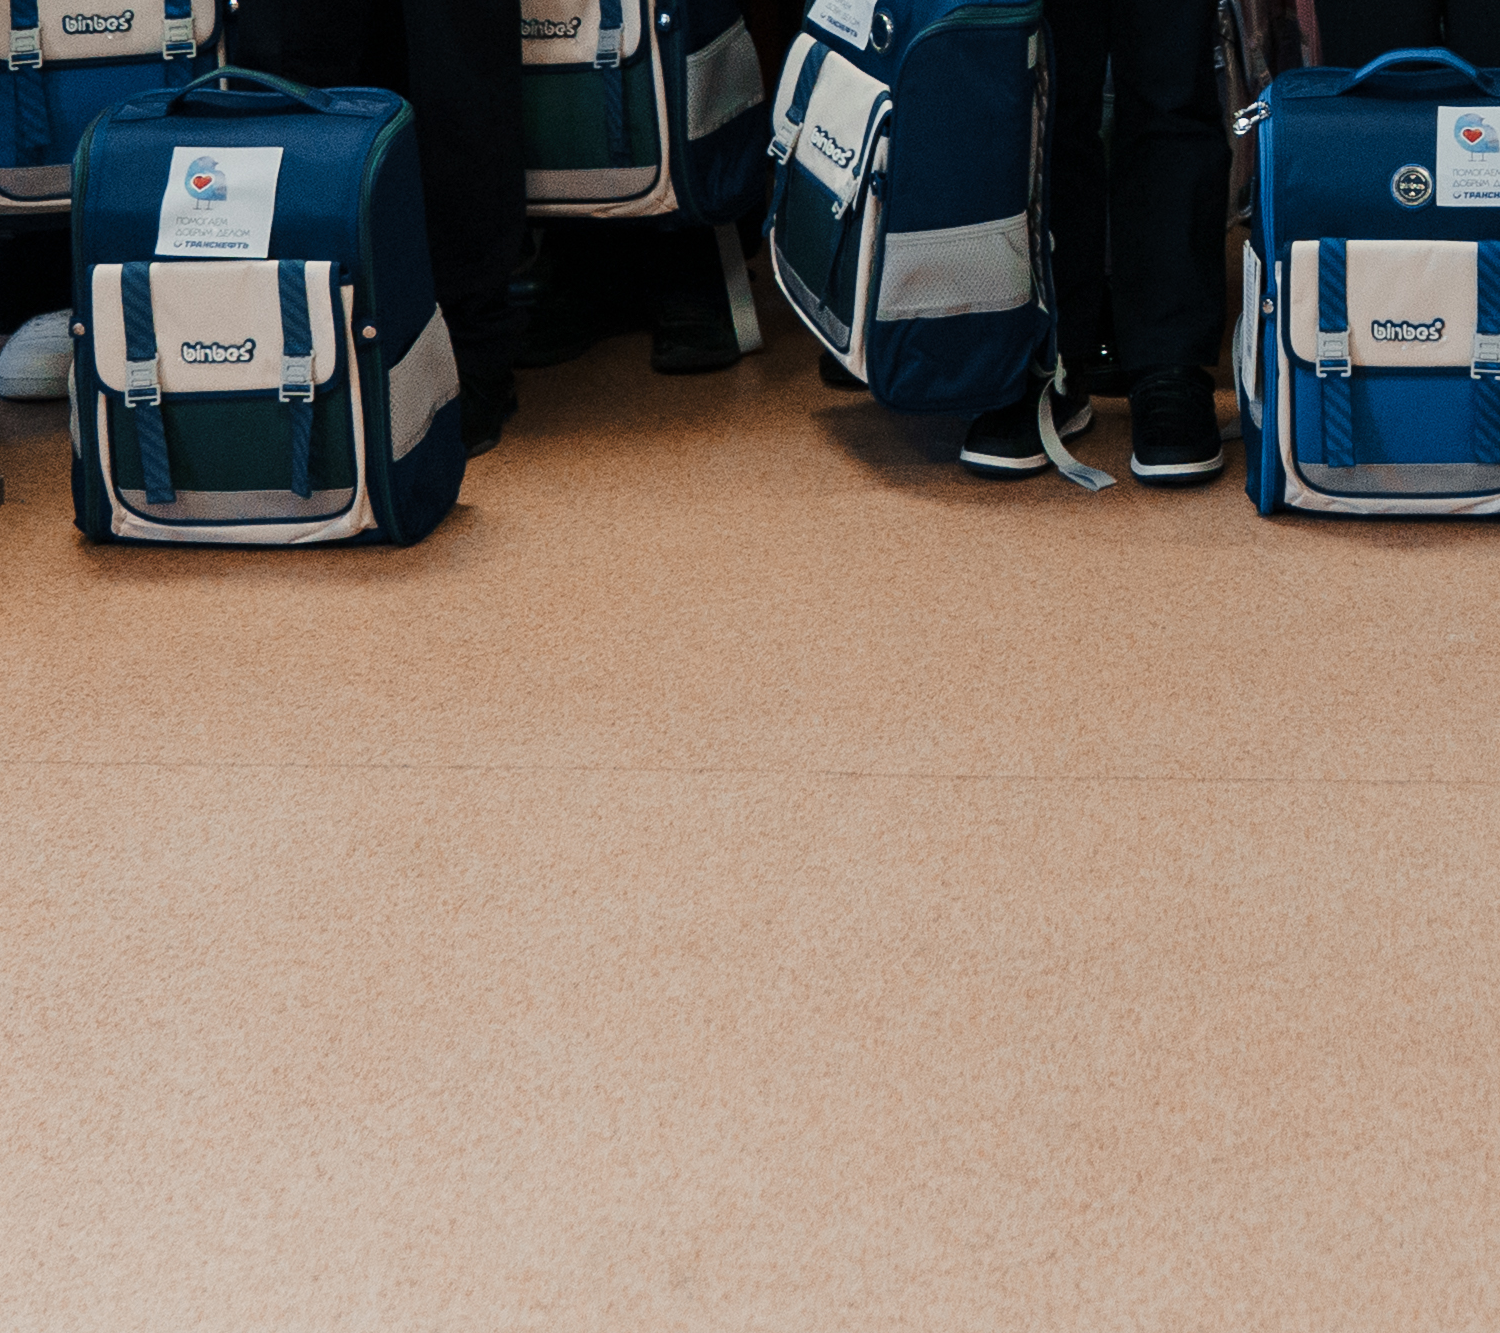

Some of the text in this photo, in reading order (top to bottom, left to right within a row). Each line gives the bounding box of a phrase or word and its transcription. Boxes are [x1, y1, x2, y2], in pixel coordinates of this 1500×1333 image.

[64, 11, 133, 33] binbes
[1452, 179, 1491, 188] ДОБРЫМ
[175, 216, 229, 227] ПОМОГАЕМ
[174, 228, 251, 238] ДОБРЫМ ДЕЛОМ
[184, 240, 250, 250] ТРАНСНЕФТЬ
[1373, 319, 1443, 341] binbes
[182, 341, 254, 362] binbes
